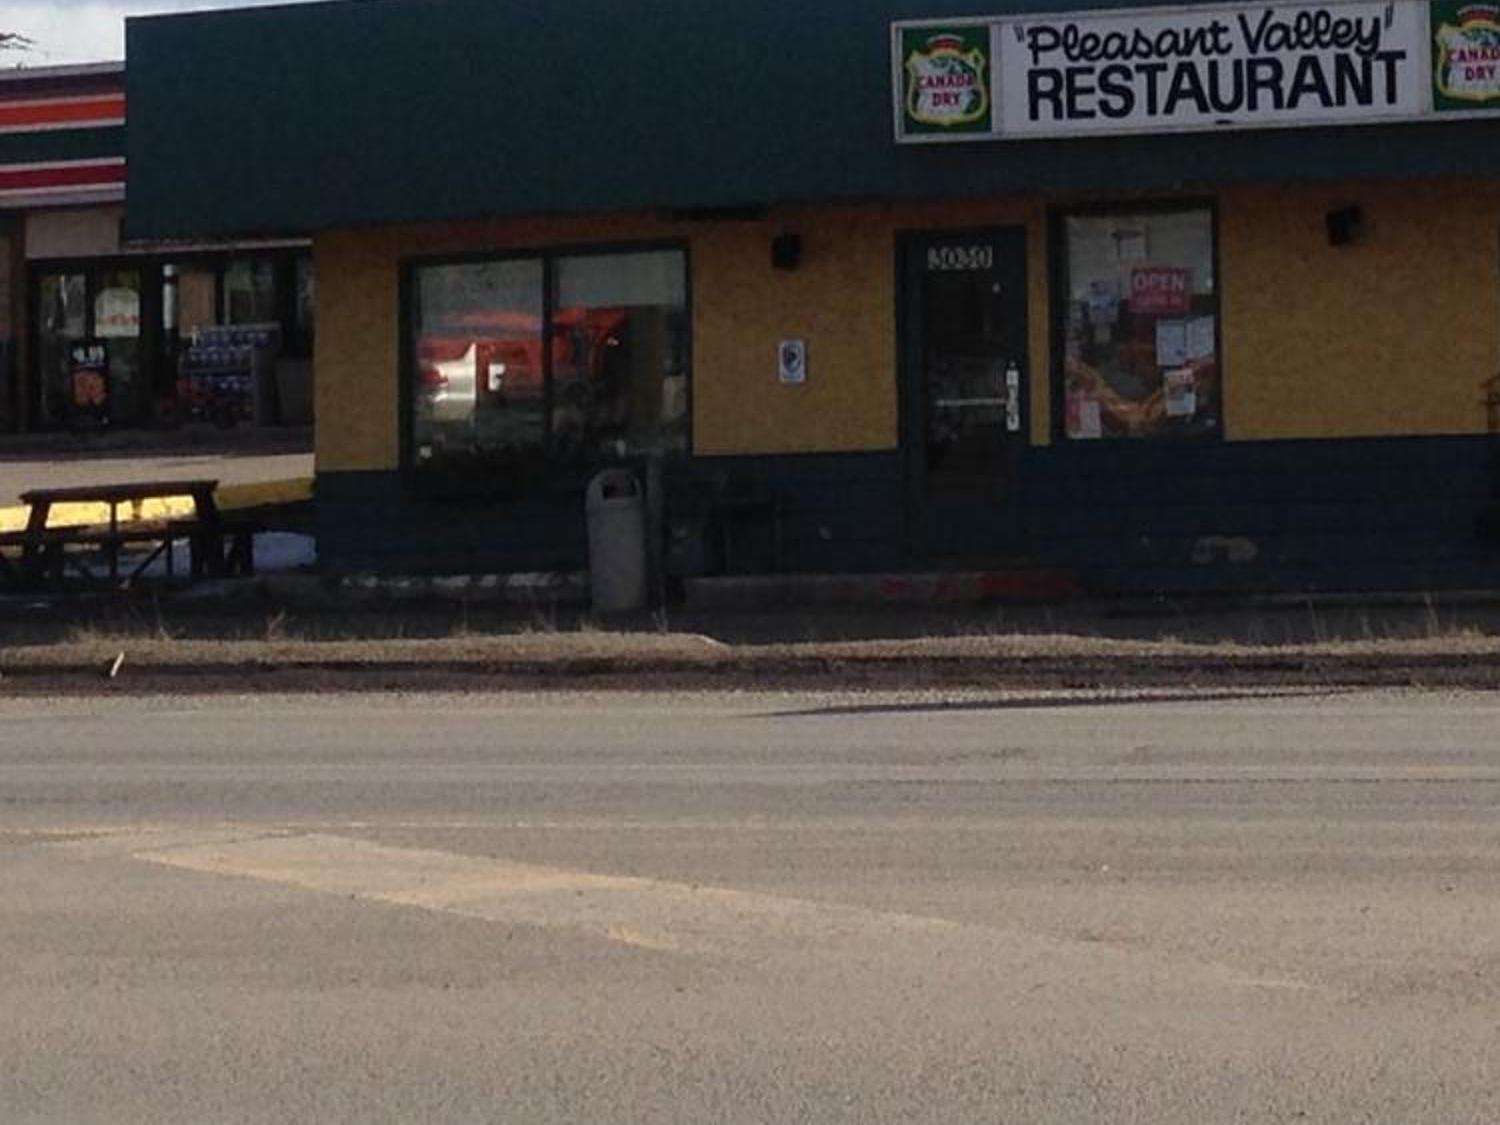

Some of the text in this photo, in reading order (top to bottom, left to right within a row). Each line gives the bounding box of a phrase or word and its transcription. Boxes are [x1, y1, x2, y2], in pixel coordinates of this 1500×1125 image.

[1465, 66, 1495, 81] DRY
[917, 74, 977, 91] CANADA
[1028, 50, 1407, 121] RESTAURANT
[931, 92, 961, 108] DRY
[1133, 270, 1184, 289] OPEN
